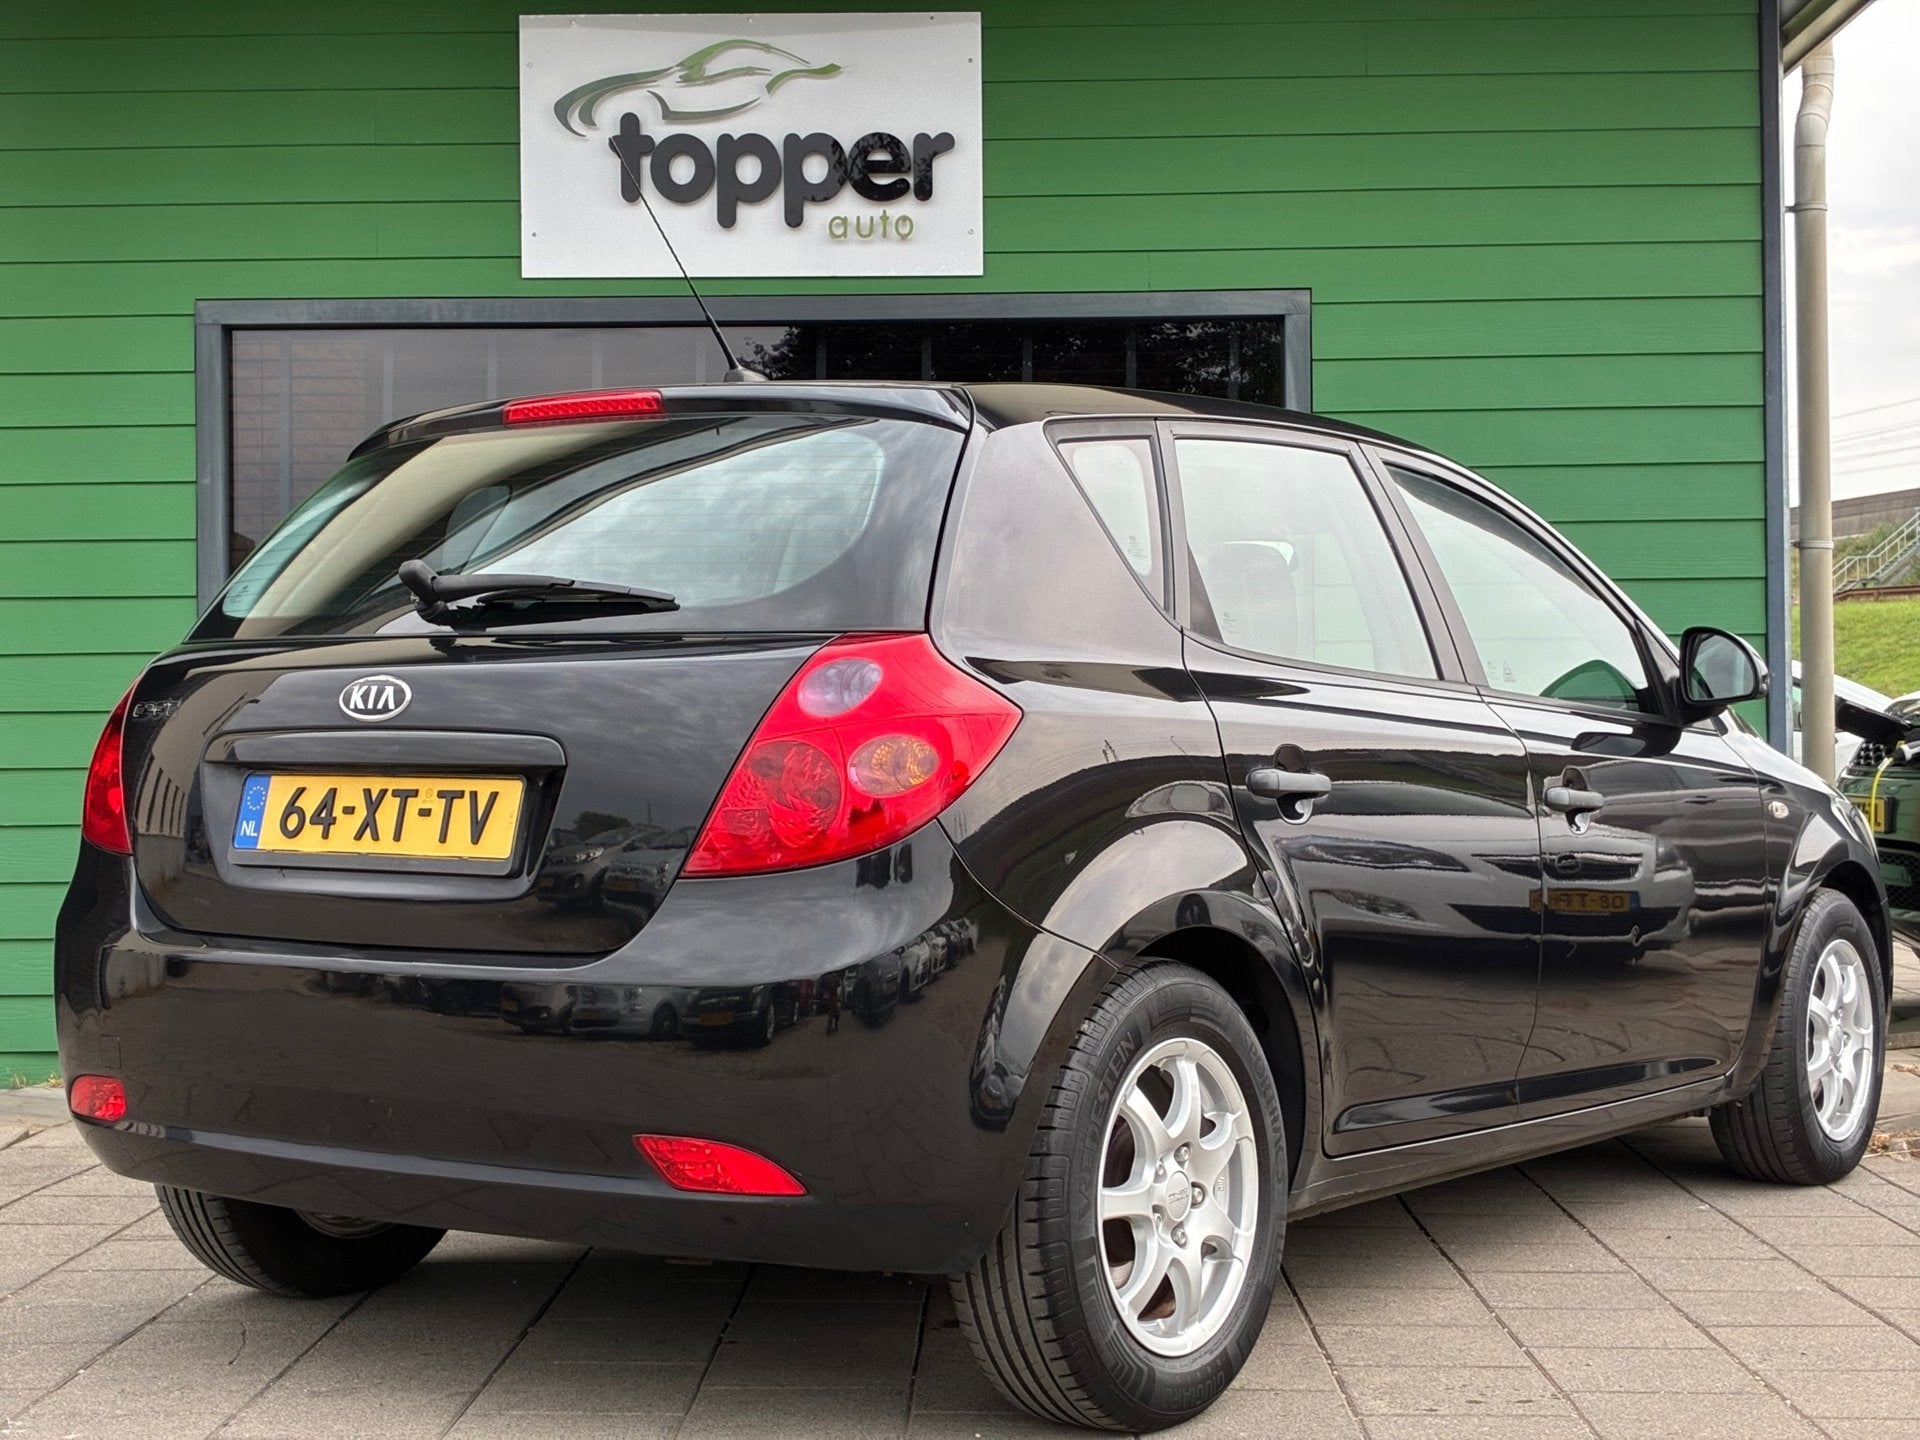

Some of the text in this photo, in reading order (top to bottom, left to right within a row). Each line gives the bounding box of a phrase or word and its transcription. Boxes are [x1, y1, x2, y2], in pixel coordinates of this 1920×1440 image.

[608, 112, 956, 229] topper
[828, 209, 914, 240] auto
[348, 685, 396, 711] KIA
[240, 820, 258, 838] NL
[279, 787, 499, 845] 64-XT-TV
